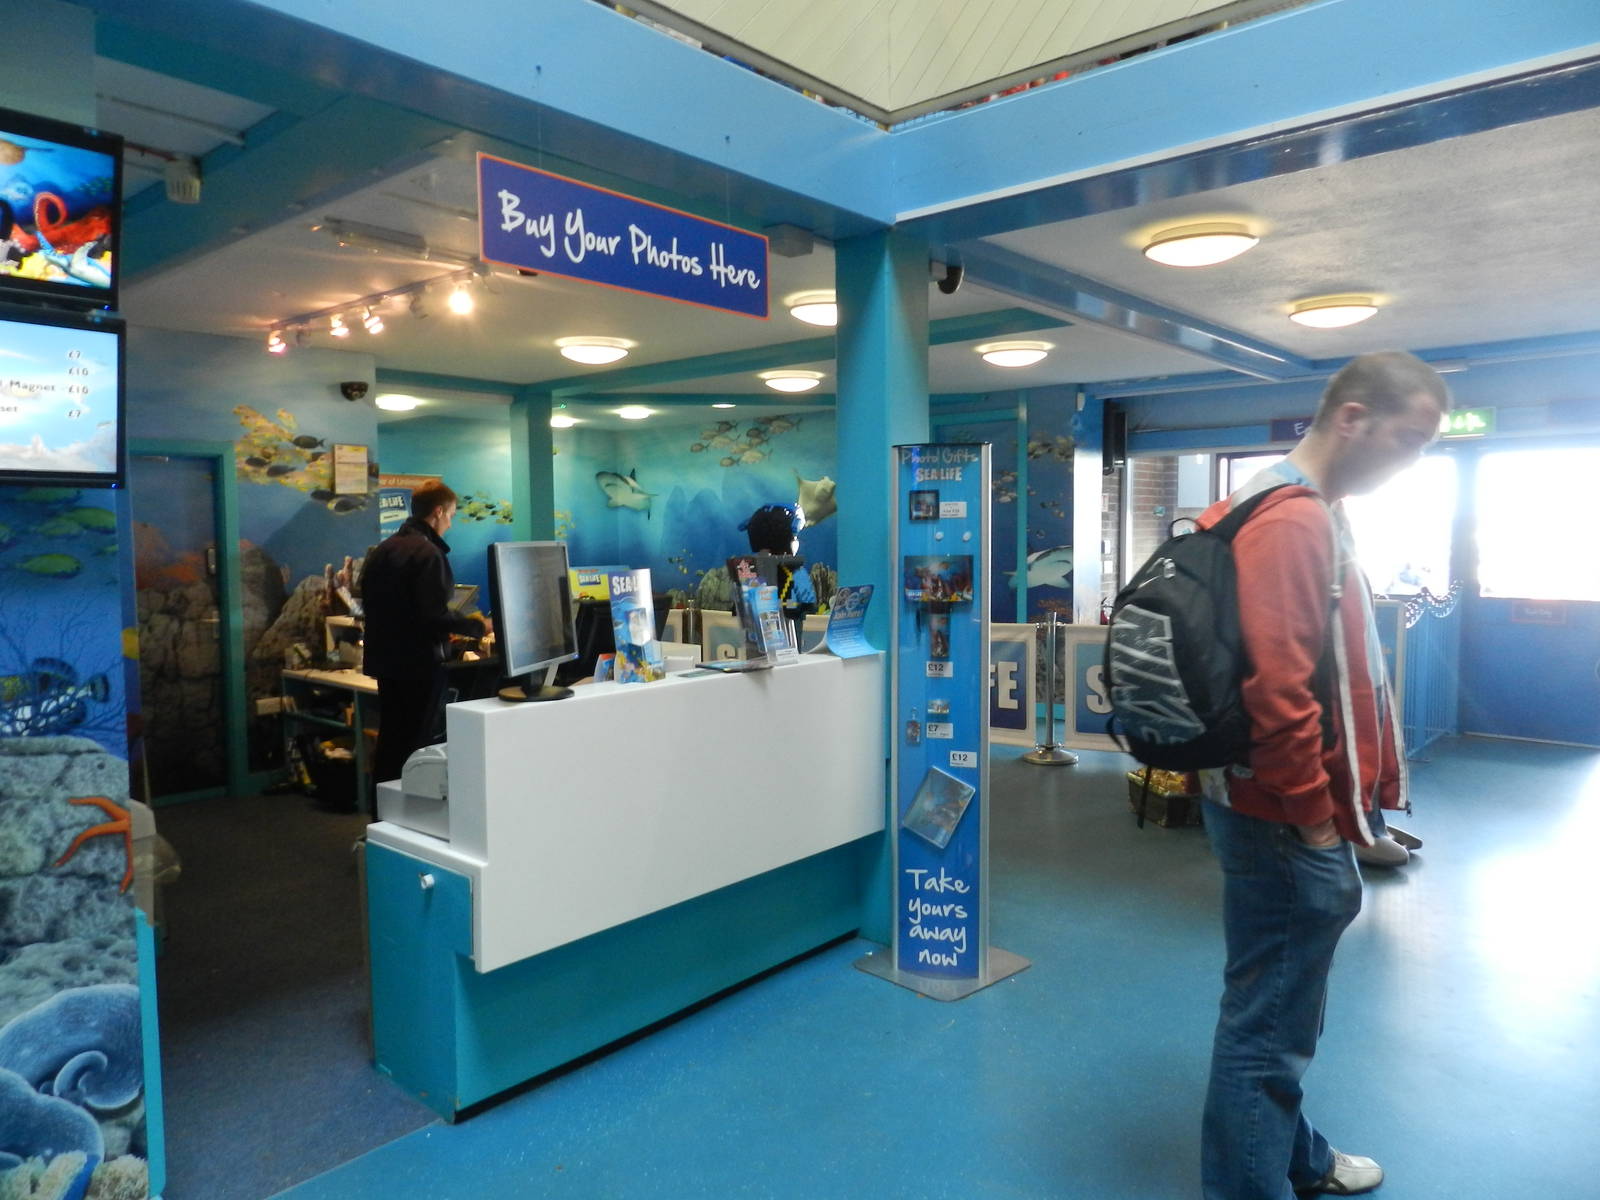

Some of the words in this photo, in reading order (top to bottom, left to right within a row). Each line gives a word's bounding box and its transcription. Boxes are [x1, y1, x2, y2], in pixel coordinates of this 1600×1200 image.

[498, 189, 555, 258] Buy
[564, 208, 620, 264] Your
[628, 223, 703, 277] Photos
[709, 241, 760, 290] Here
[9, 380, 56, 393] Magnet
[943, 447, 979, 464] Gifts
[915, 467, 938, 482] SEA
[612, 575, 632, 596] SEA
[927, 663, 944, 672] £12
[927, 724, 939, 732] £7
[952, 753, 968, 761] £12
[905, 867, 970, 894] Take
[908, 897, 968, 924] yours
[908, 924, 967, 953] away
[918, 948, 958, 966] now
